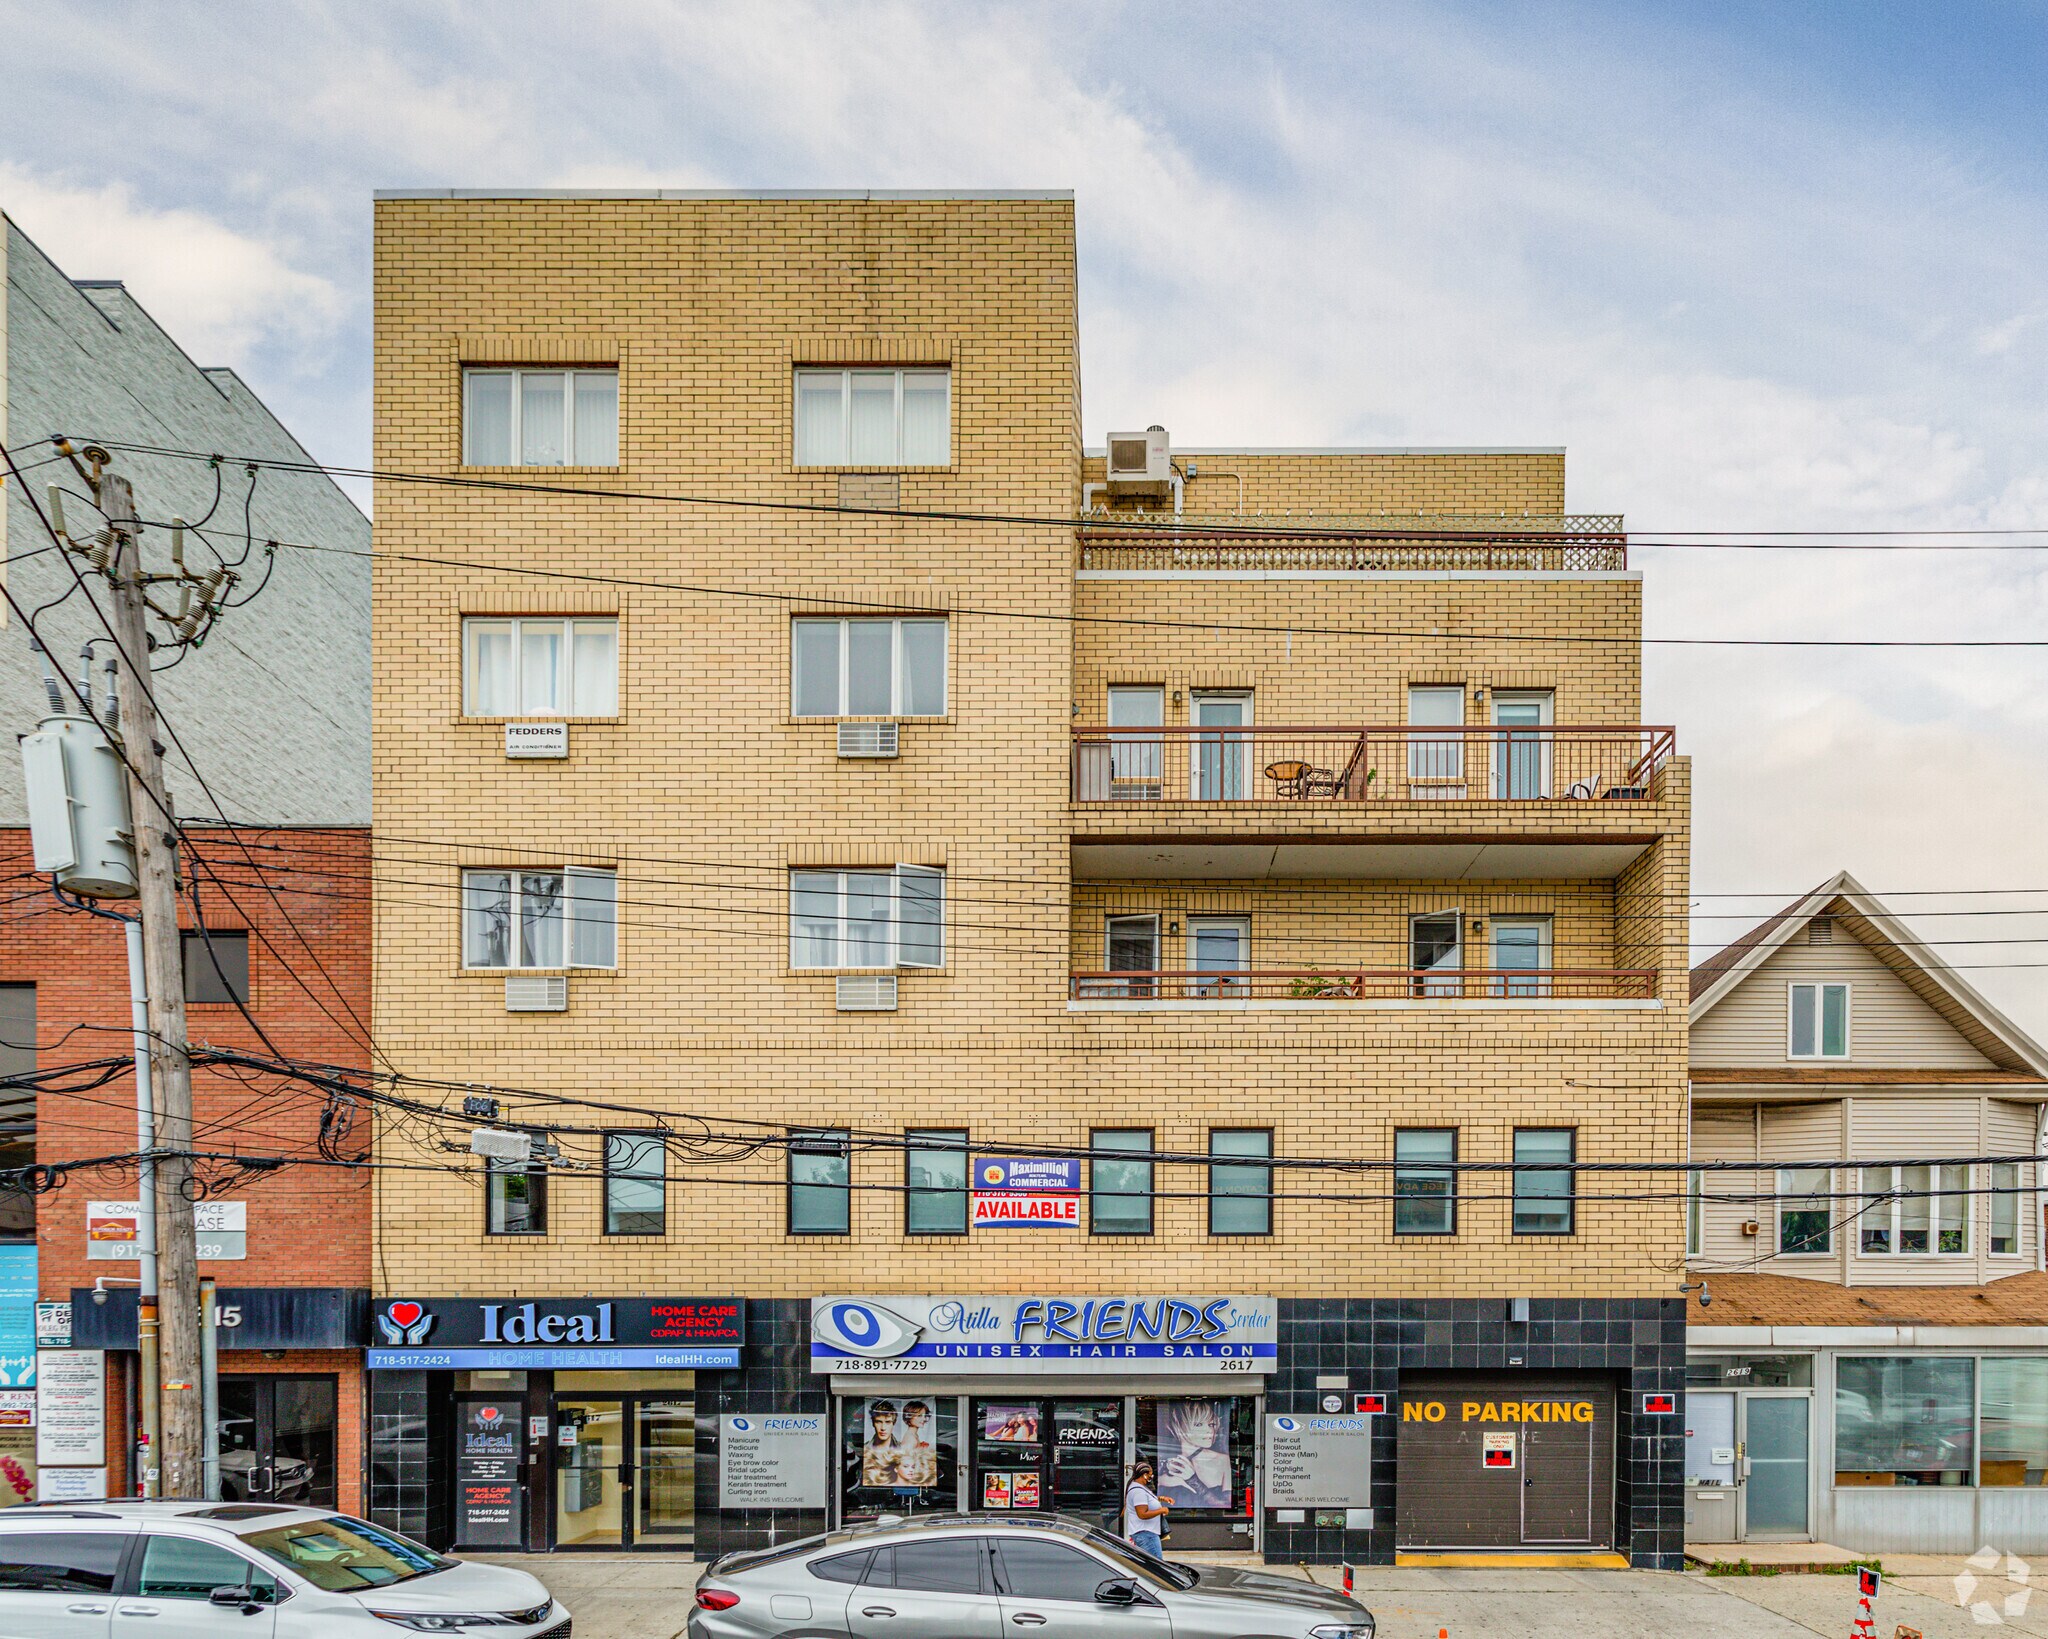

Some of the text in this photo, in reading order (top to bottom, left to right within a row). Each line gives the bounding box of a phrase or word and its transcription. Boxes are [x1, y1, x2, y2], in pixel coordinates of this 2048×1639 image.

[1009, 1178, 1068, 1187] COMMERCIAL
[195, 1204, 224, 1214] PACE
[975, 1201, 1076, 1218] AVAILABLE
[195, 1216, 225, 1230] ASE
[195, 1244, 222, 1257] 239
[214, 1306, 242, 1328] 15
[651, 1306, 738, 1316] HOME CARE
[479, 1303, 615, 1344] Ideal
[664, 1317, 725, 1328] AGENCY
[928, 1298, 1272, 1343] Atilla FRIENDS Serdar
[650, 1329, 738, 1338] CDPAP & HHA/PCA
[936, 1345, 1254, 1358] UNISEX HAIR SALON
[375, 1352, 732, 1366] 718-517-2424 HOME HEALTH IdealHH.com
[1220, 1360, 1254, 1370] 2617
[1403, 1402, 1594, 1422] NO PARKING
[764, 1418, 818, 1430] FRIENDS
[1309, 1419, 1364, 1430] FRIENDS
[466, 1432, 512, 1448] Ideal
[1059, 1428, 1116, 1440] FRIENDS
